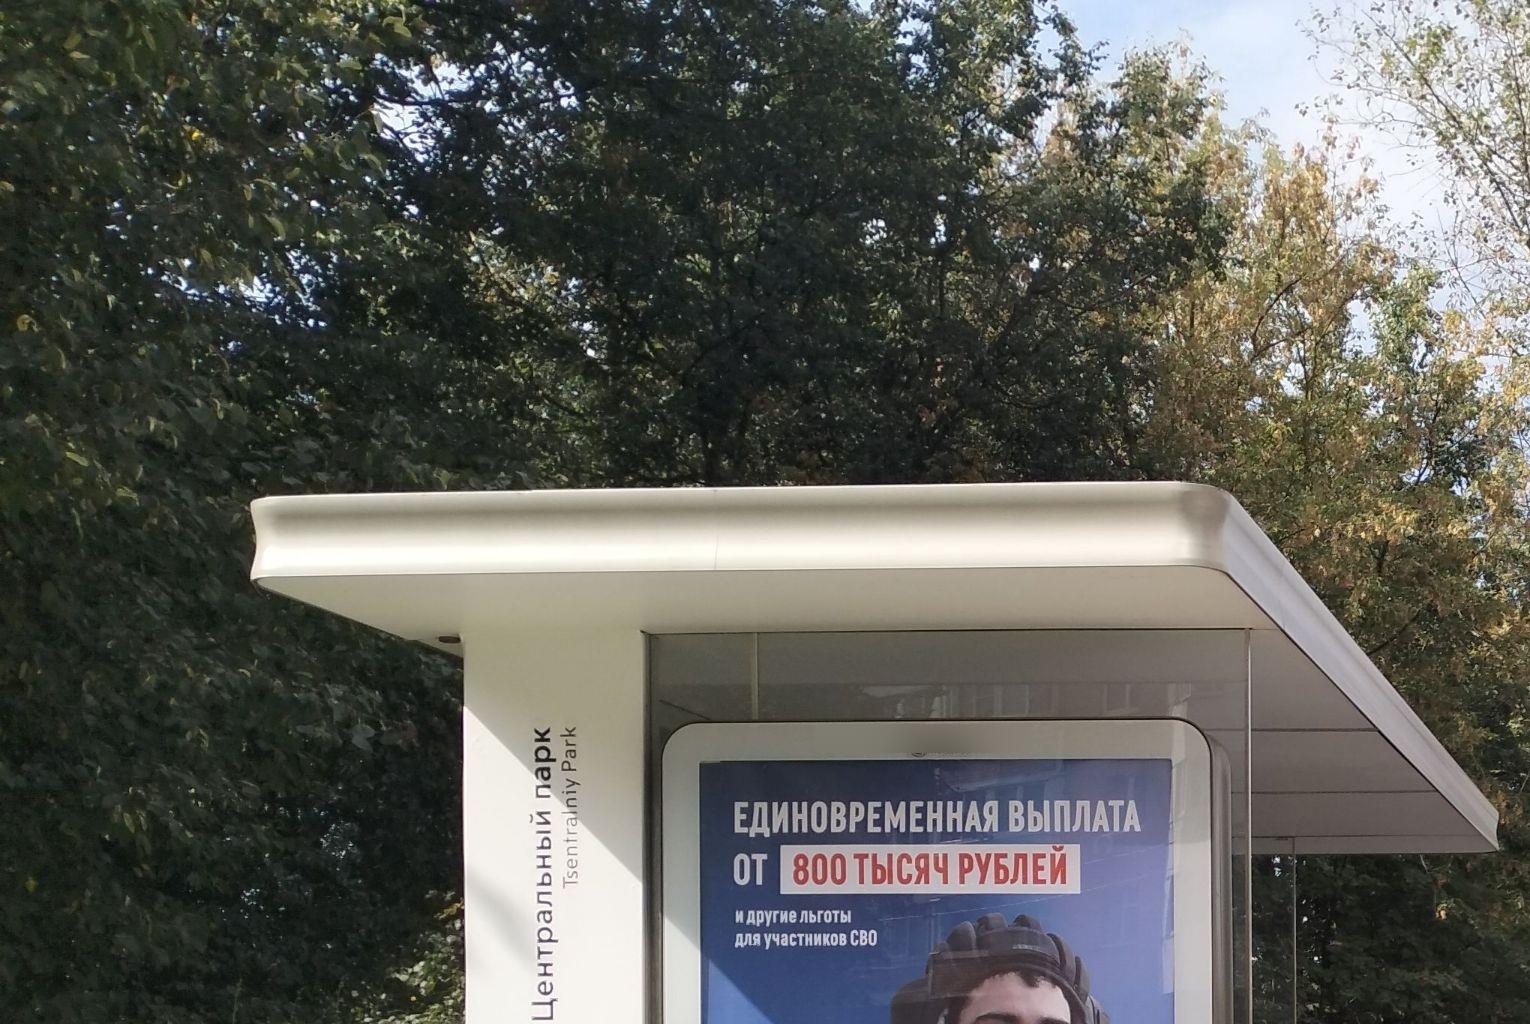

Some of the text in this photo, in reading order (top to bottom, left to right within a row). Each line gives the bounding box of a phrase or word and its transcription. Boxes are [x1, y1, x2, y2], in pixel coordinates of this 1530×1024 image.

[560, 726, 581, 889] Tsentralniy Park
[733, 799, 1142, 837] ЕДИНОВРЕМЕННАЯ ВЫПЛАТА
[529, 727, 559, 1021] Центральный парк
[733, 845, 1067, 886] ОТ 800 ТЫСЯЧ РУБЛЕЙ
[735, 910, 851, 927] и другие льготы
[735, 929, 878, 950] для участников СВО
